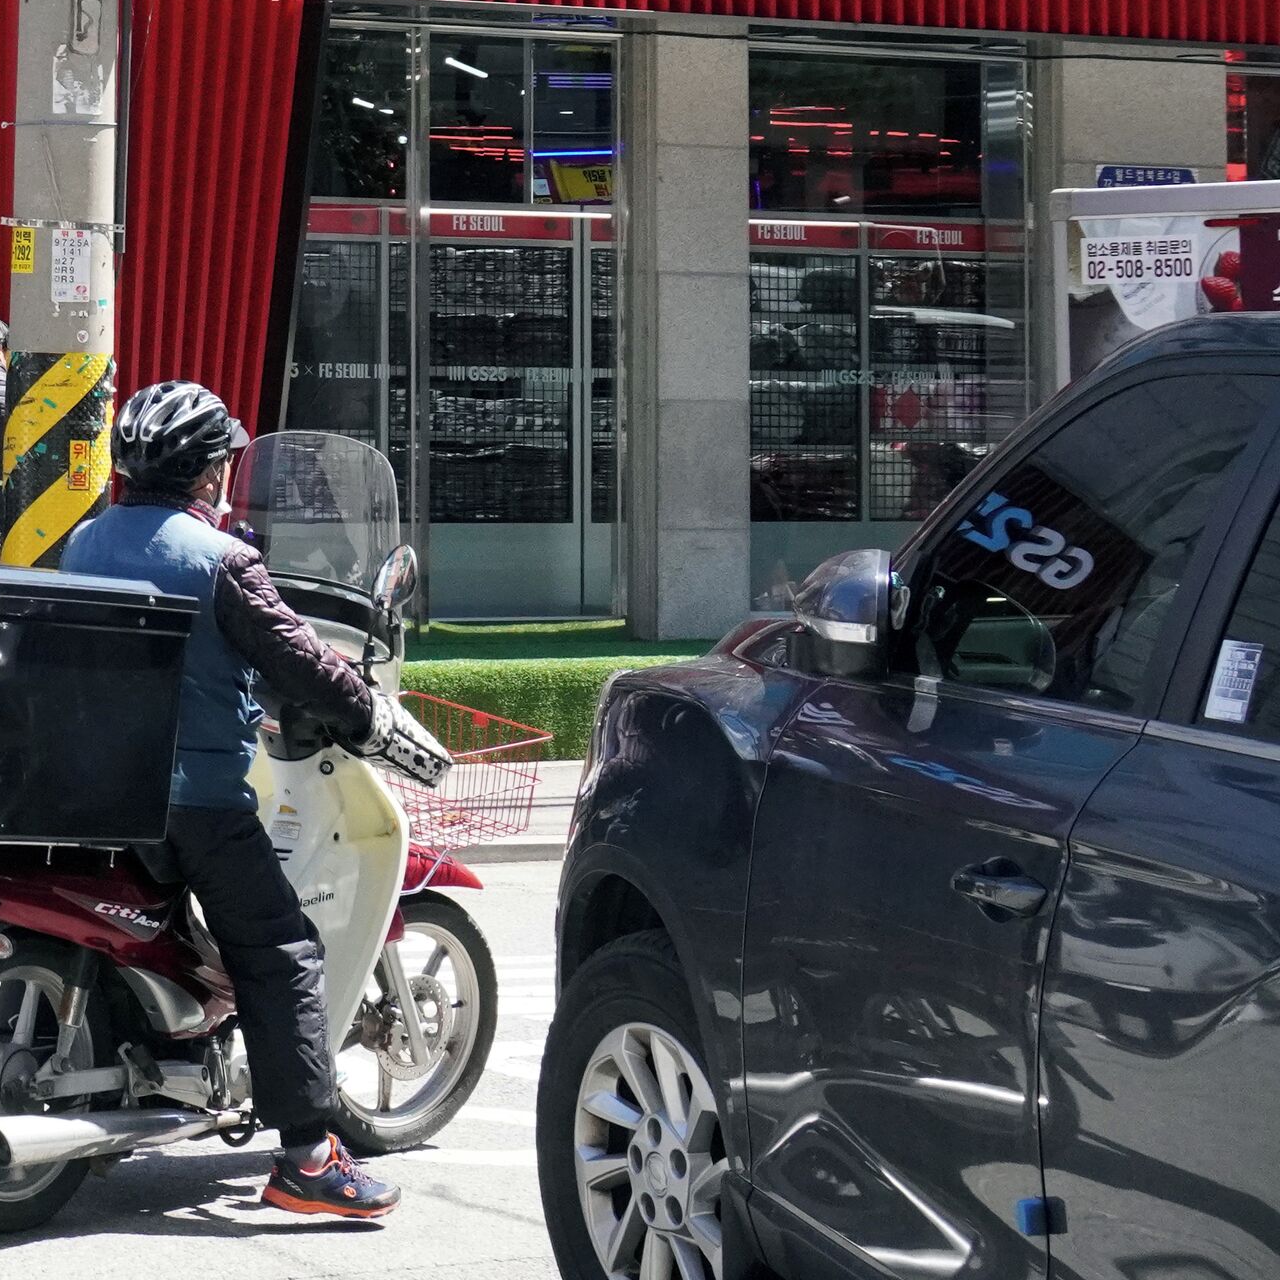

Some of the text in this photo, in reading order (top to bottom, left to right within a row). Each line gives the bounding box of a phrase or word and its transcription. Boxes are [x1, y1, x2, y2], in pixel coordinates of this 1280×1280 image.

[452, 215, 506, 232] FC SEOUL
[757, 224, 807, 241] FC SEOUL
[931, 229, 964, 245] SEOUL
[1087, 239, 1192, 257] 업소용제품 취급문의
[1087, 257, 1192, 280] 02-508-8500
[318, 363, 333, 379] FC
[335, 363, 371, 379] SEOUL
[467, 367, 508, 382] GS25
